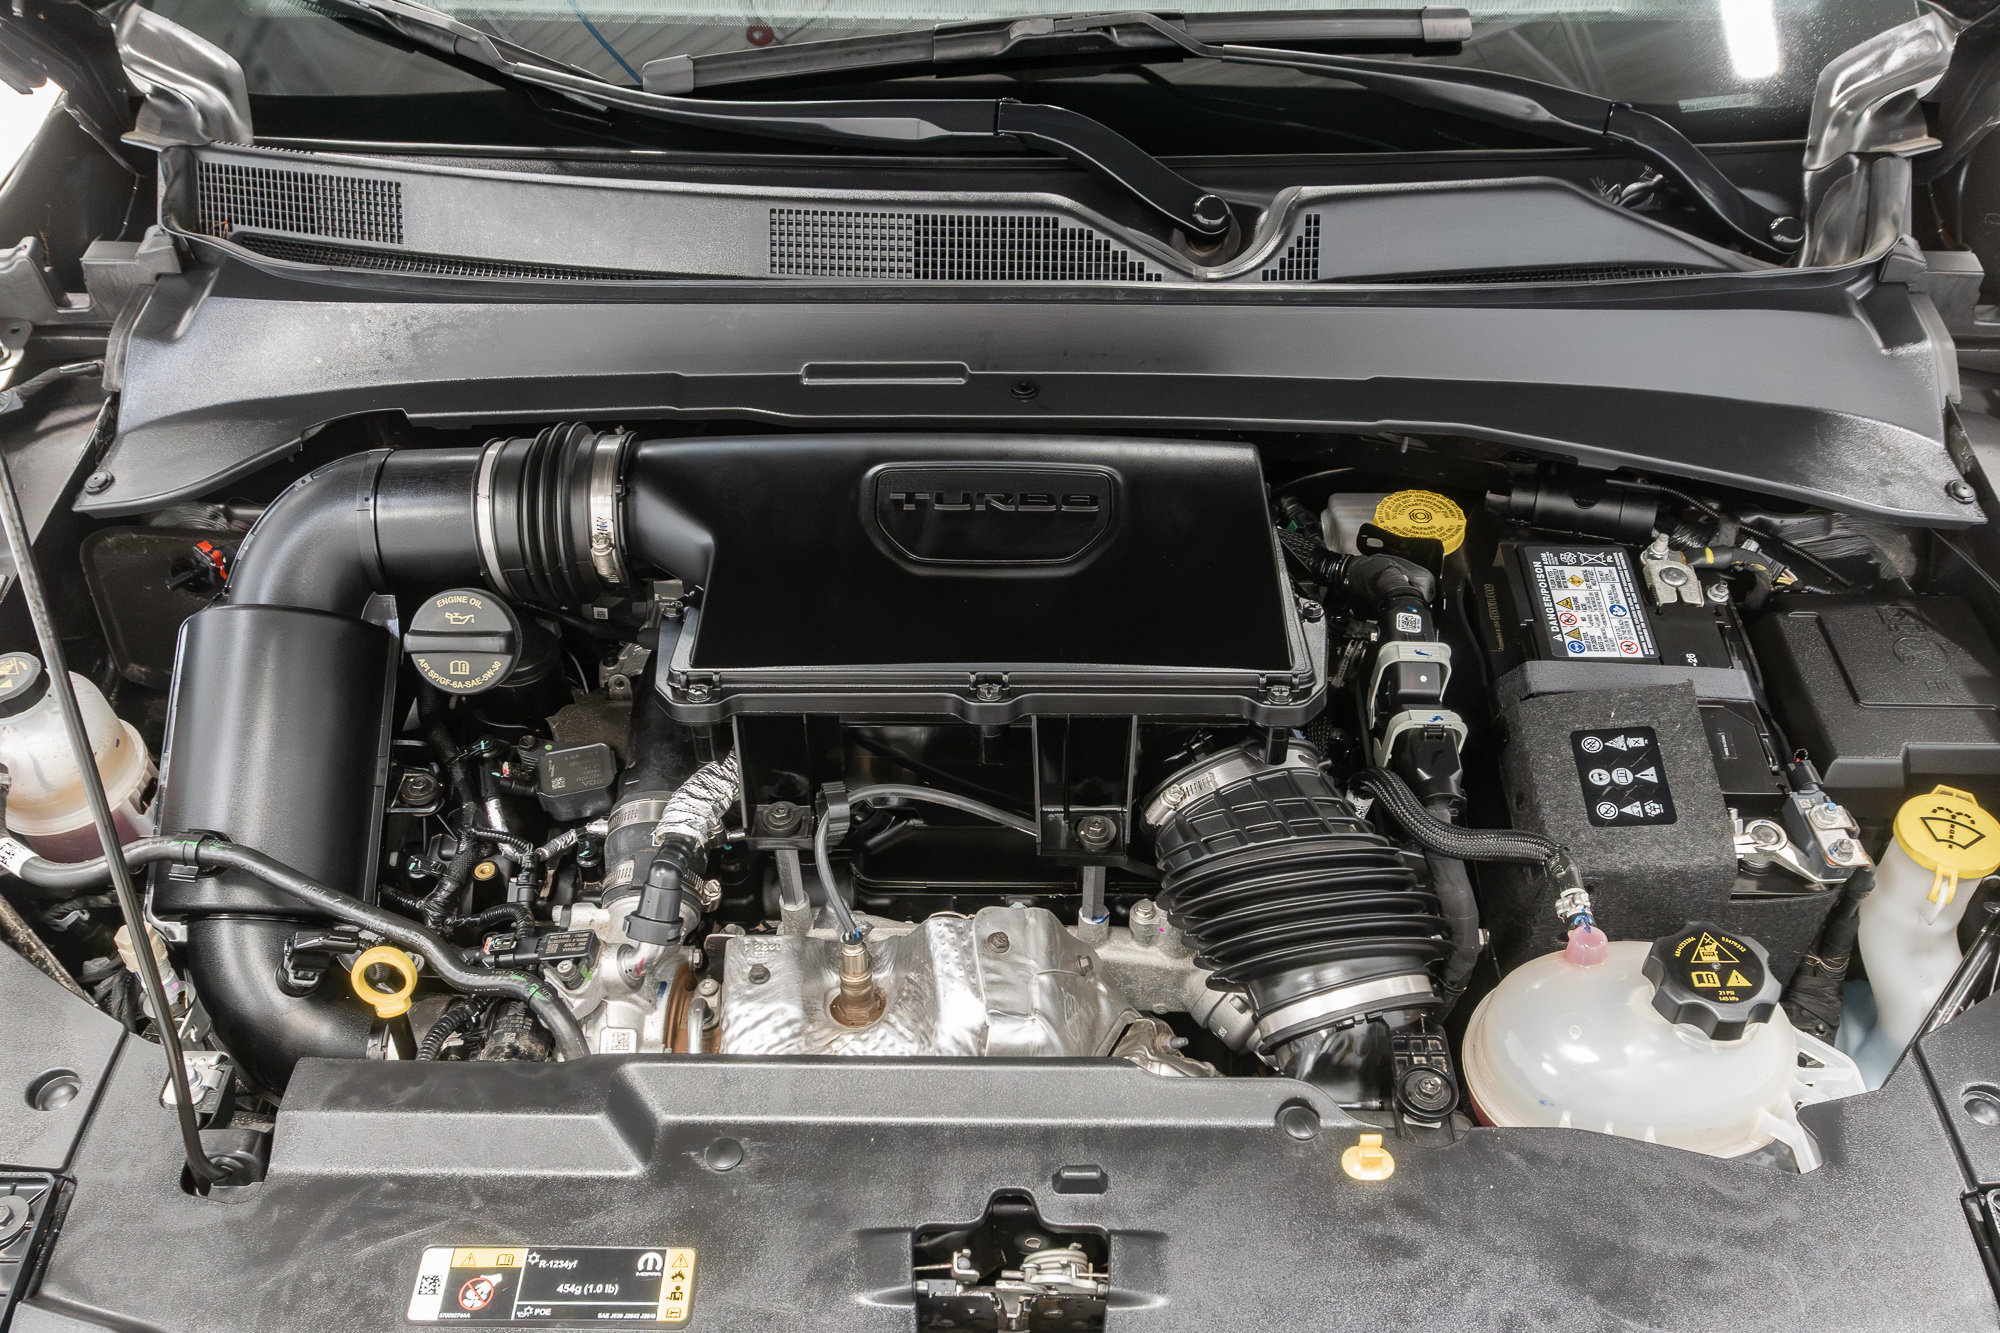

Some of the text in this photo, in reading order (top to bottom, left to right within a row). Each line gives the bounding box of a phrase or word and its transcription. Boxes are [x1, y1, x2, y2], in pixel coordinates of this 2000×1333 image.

[888, 491, 1101, 513] TURBO
[1541, 553, 1549, 565] AGM
[436, 595, 482, 610] ENGINE OIL
[1533, 561, 1559, 632] DANGER/POISON
[417, 658, 431, 672] API
[539, 1260, 578, 1270] R-1234yf
[556, 1284, 619, 1295] 454g (1.0 lb)
[534, 1308, 552, 1316] POE
